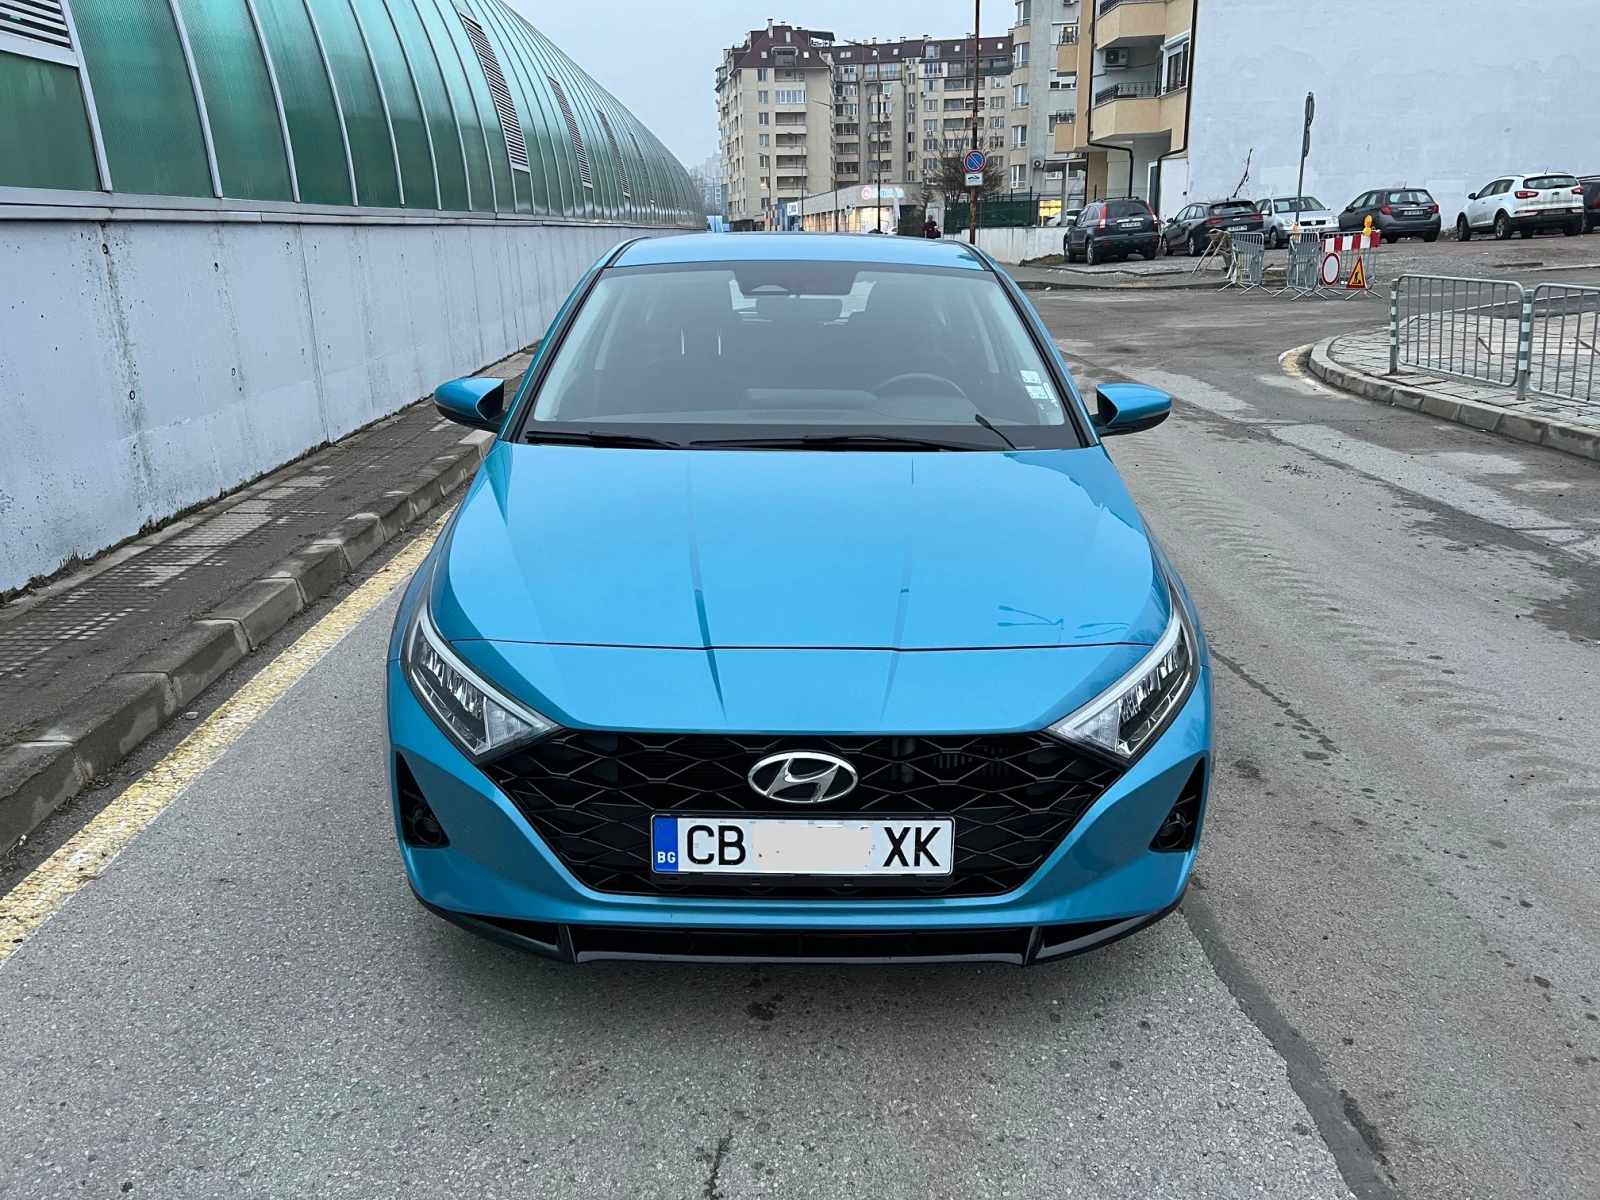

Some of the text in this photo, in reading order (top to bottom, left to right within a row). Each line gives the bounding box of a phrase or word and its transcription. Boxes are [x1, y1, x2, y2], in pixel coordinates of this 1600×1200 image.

[657, 851, 676, 864] BG
[687, 825, 746, 866] CB
[882, 827, 941, 867] XK
